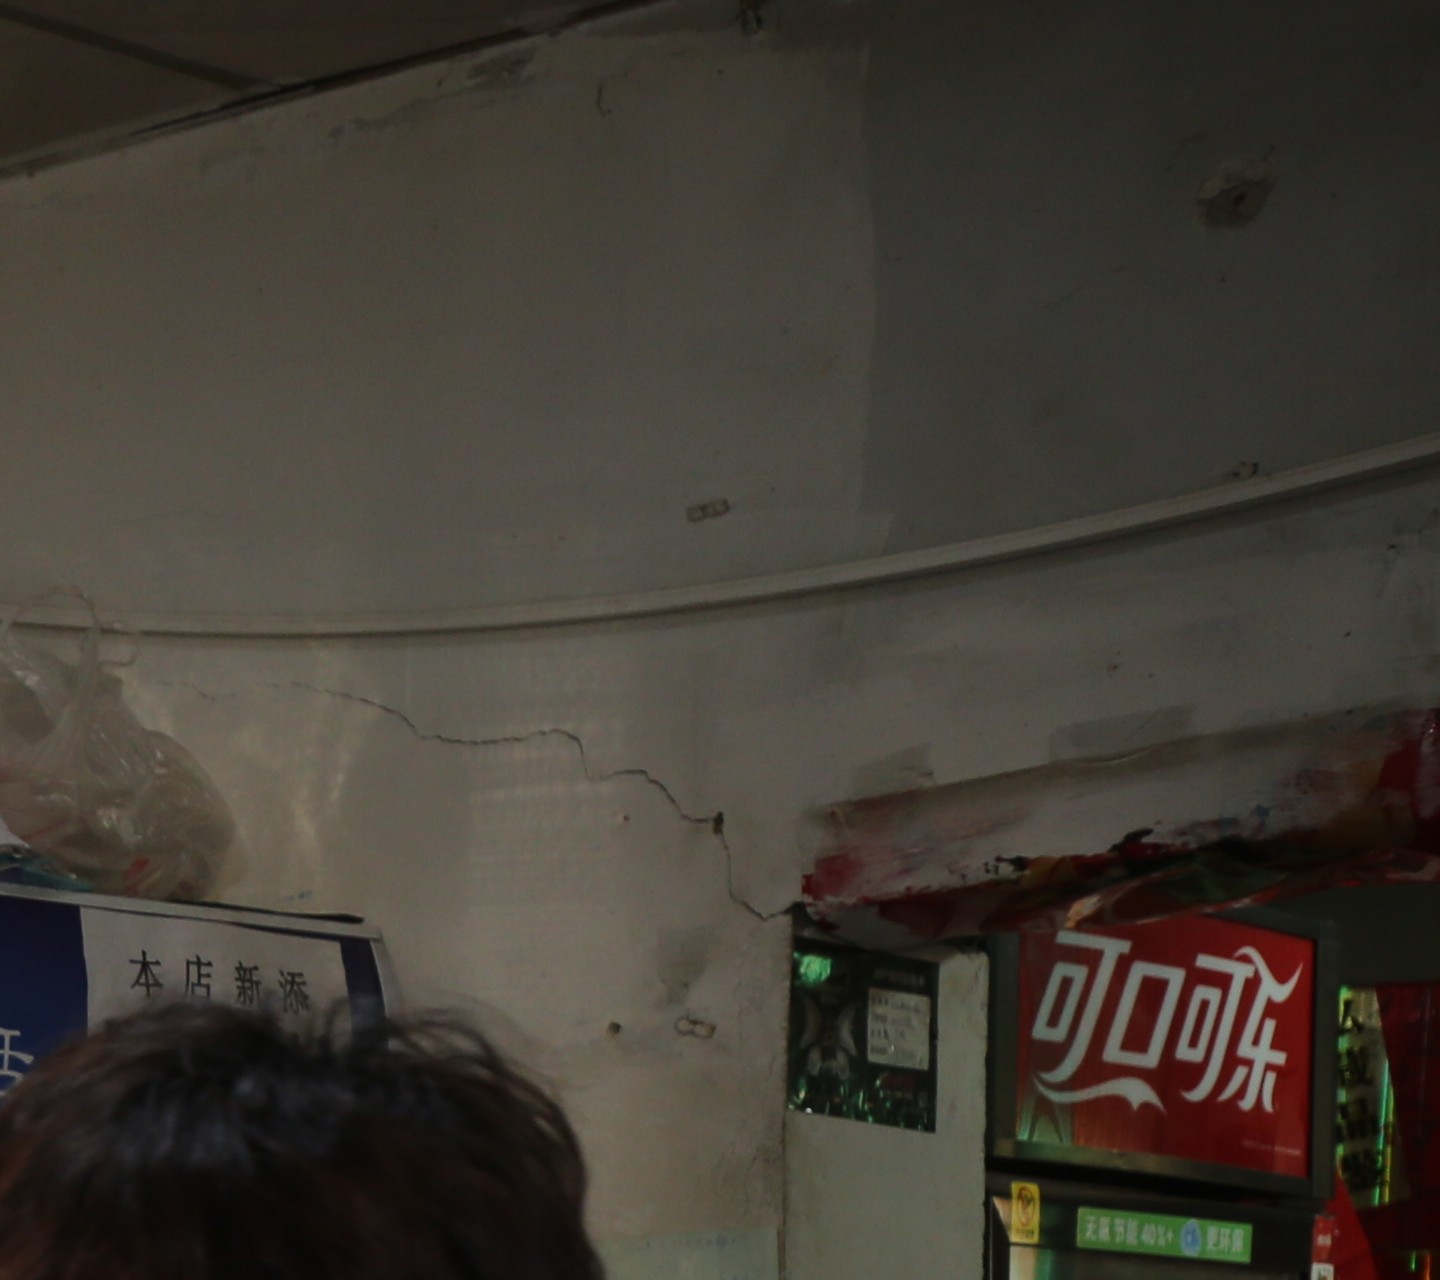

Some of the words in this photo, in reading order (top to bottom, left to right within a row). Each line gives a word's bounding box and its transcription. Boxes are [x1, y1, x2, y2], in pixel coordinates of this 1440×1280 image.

[129, 950, 310, 1014] 本店新添
[1031, 930, 1303, 1113] 可口可乐
